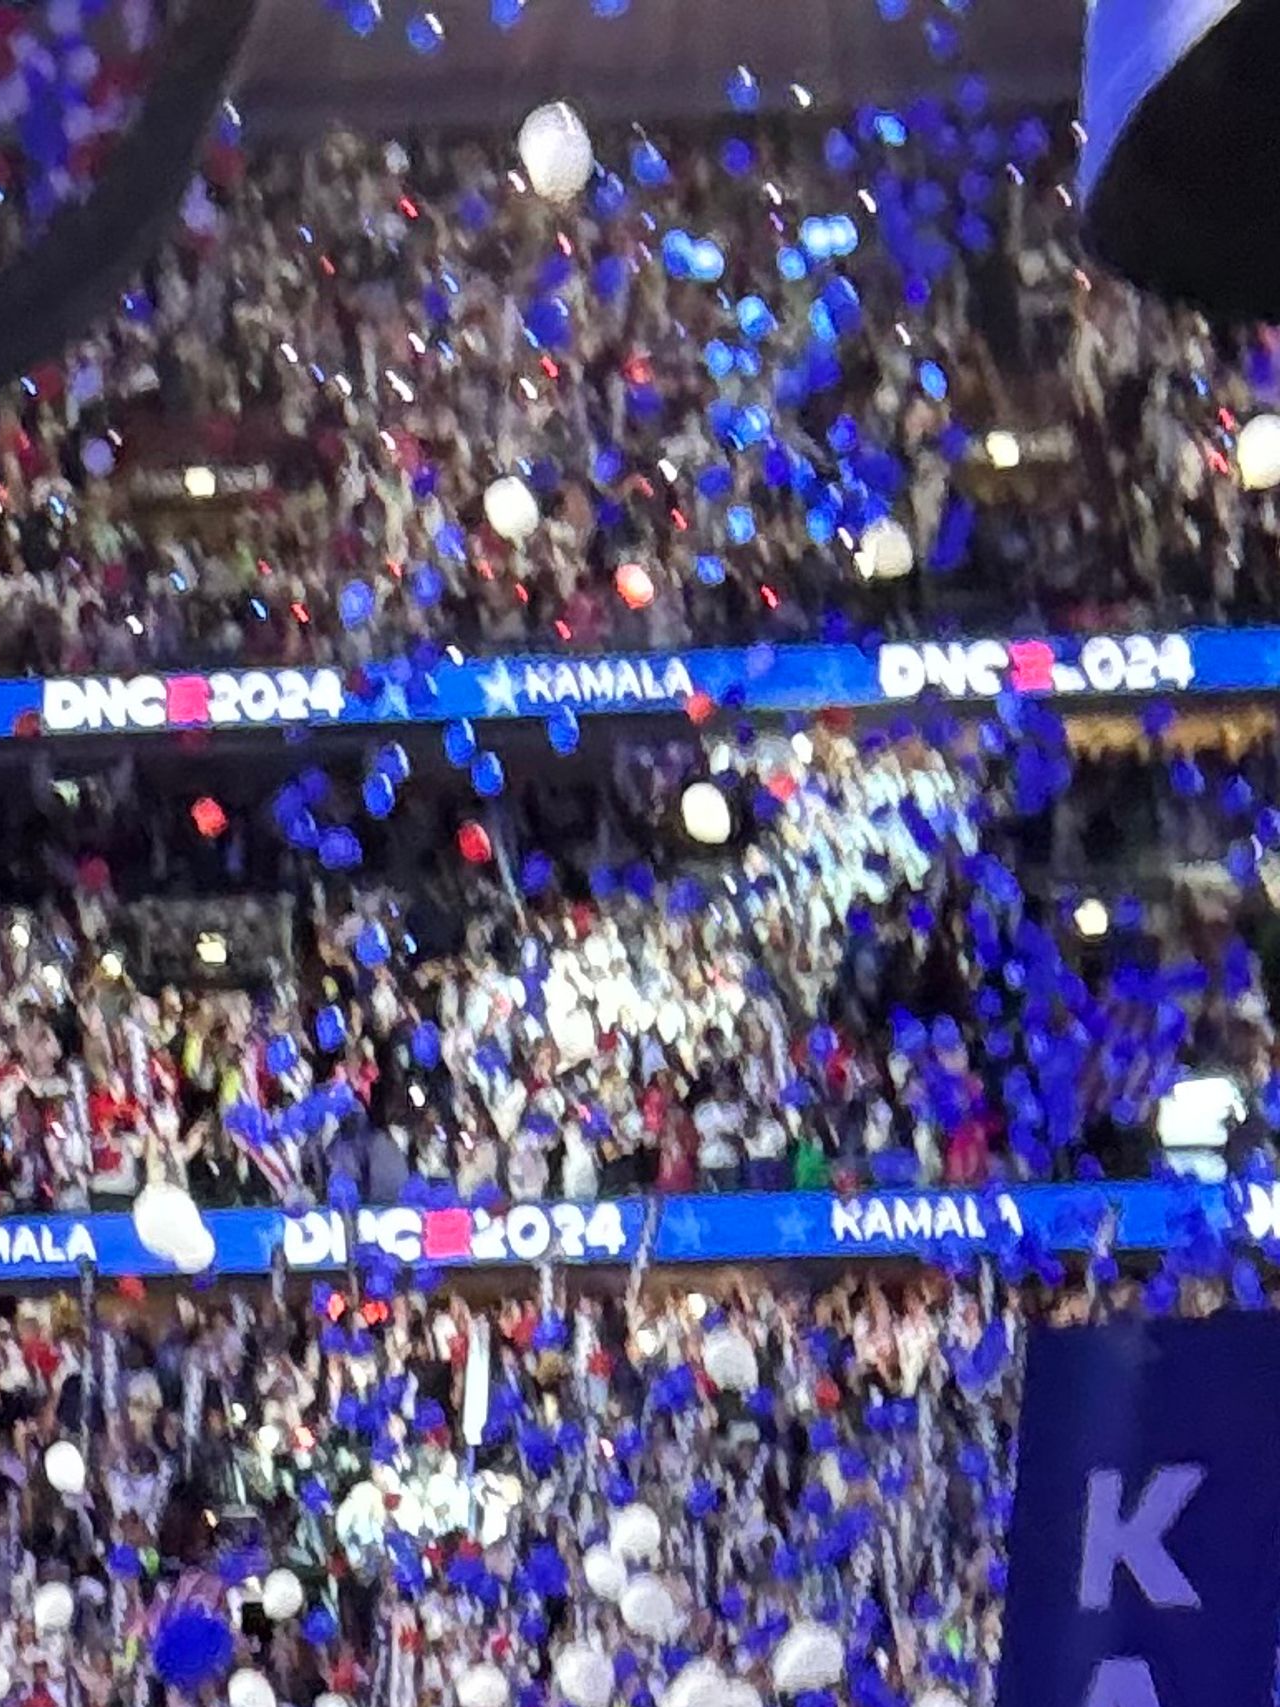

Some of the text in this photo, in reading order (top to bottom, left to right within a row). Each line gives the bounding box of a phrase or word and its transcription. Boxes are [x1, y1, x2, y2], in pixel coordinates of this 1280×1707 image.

[523, 656, 693, 704] KAMALA
[880, 641, 1008, 697] DNC
[43, 669, 342, 729] DNC 2024
